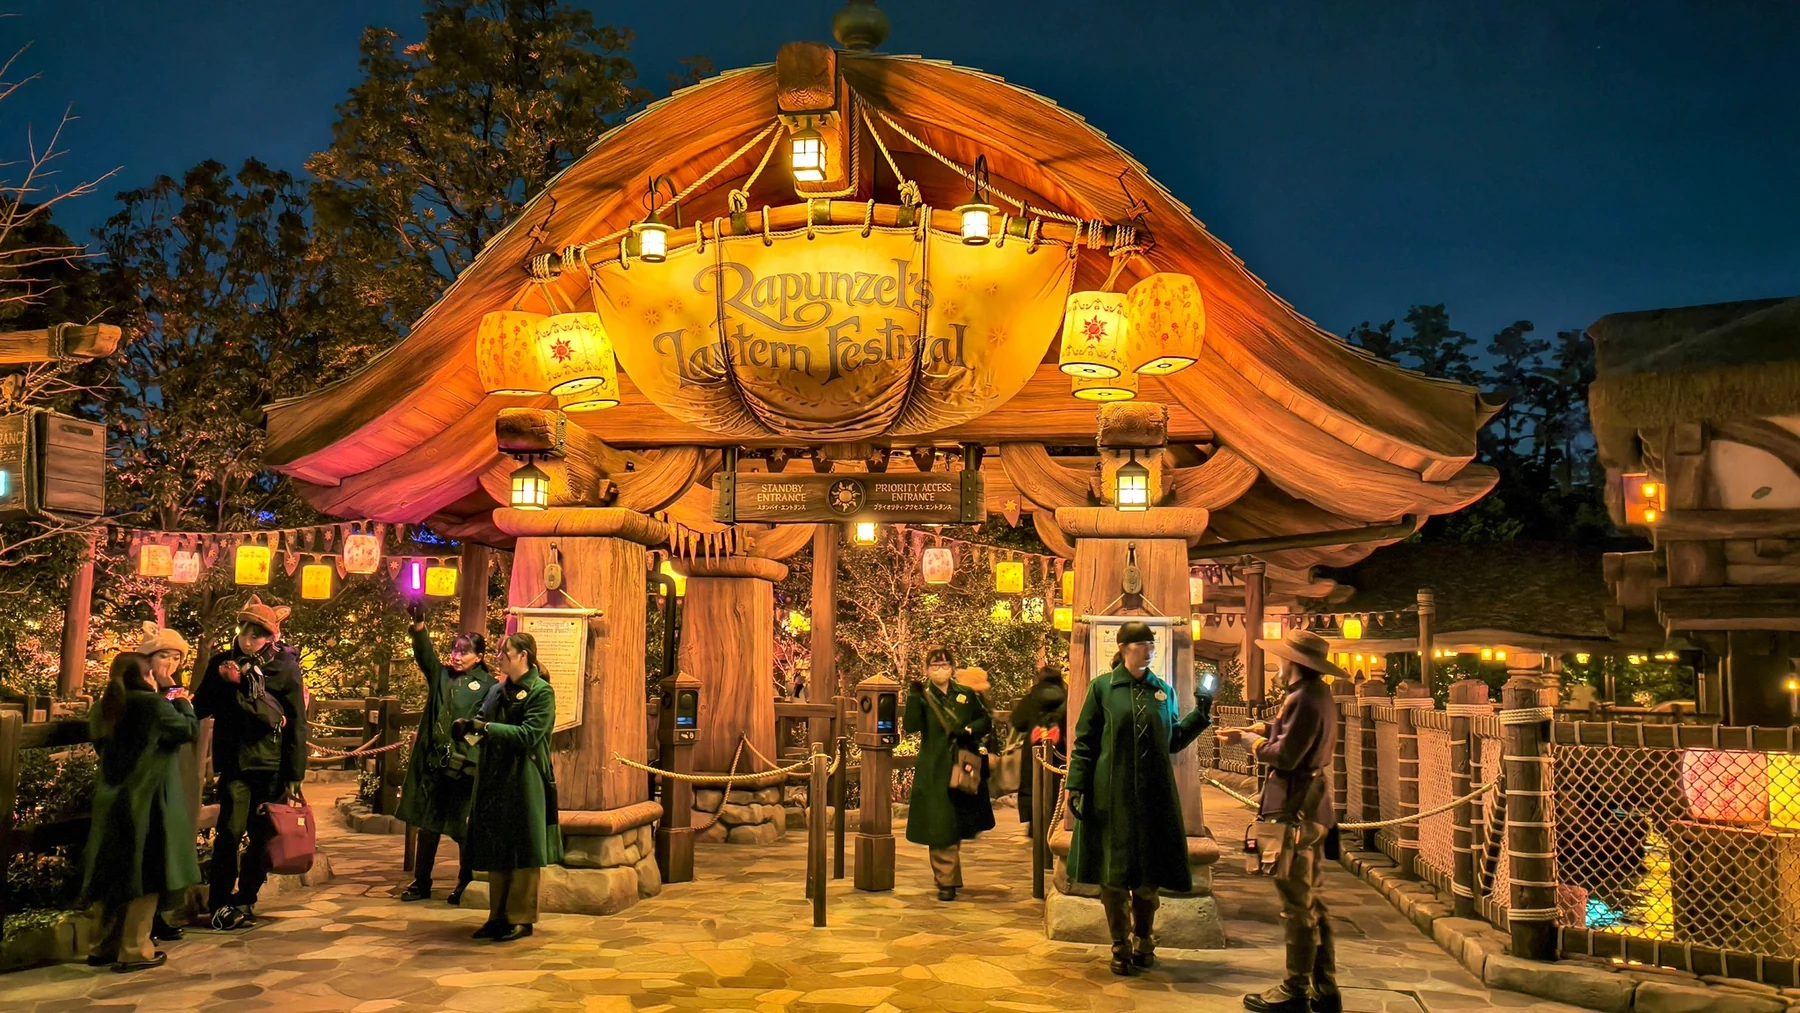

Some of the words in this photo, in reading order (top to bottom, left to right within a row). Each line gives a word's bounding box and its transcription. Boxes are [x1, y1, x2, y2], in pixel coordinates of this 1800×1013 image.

[693, 257, 934, 332] Rapunzel's
[761, 483, 804, 493] STANDBY
[875, 483, 920, 493] PRIORITY
[921, 482, 952, 492] ACCESS
[757, 493, 807, 502] ENTRANCE
[891, 492, 936, 502] ENTRANCE
